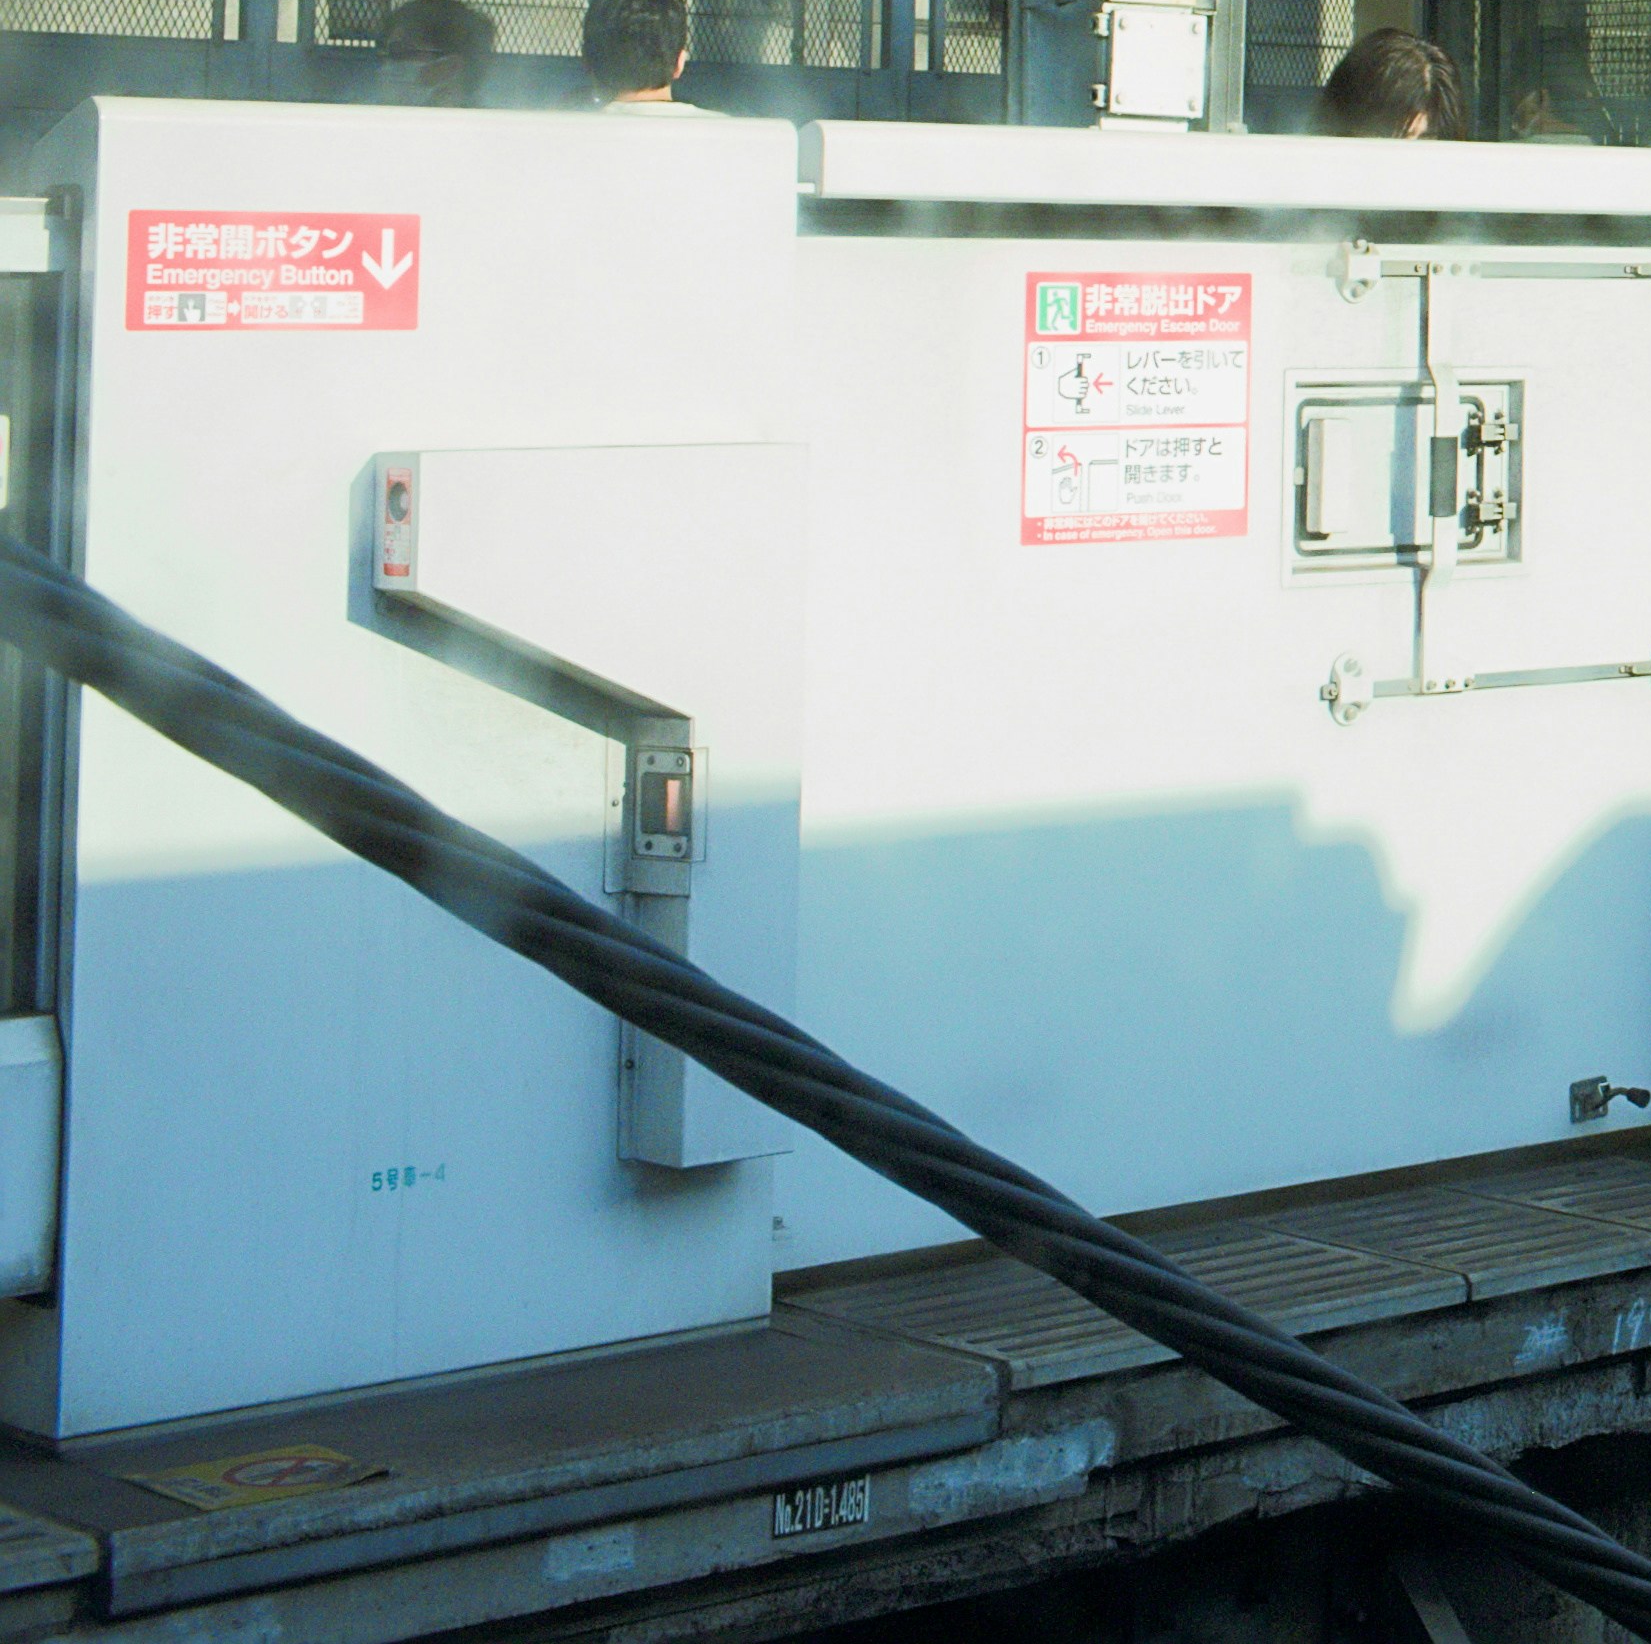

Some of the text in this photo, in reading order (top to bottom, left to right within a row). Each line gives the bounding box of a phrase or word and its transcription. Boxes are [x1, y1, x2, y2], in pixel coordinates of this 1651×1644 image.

[147, 223, 353, 260] 非常開ボタン
[147, 264, 353, 290] Emergency Button
[1085, 283, 1242, 316] 非常脱出ドア
[147, 305, 177, 321] 押す
[244, 305, 289, 320] 開ける
[1085, 319, 1240, 336] Emergency Escape Door
[1127, 350, 1245, 370] レバーを引いて
[1127, 376, 1198, 396] ください。
[1125, 436, 1223, 458] ドアは押すと
[1124, 463, 1200, 485] 開きます。
[775, 1488, 812, 1536] No.21
